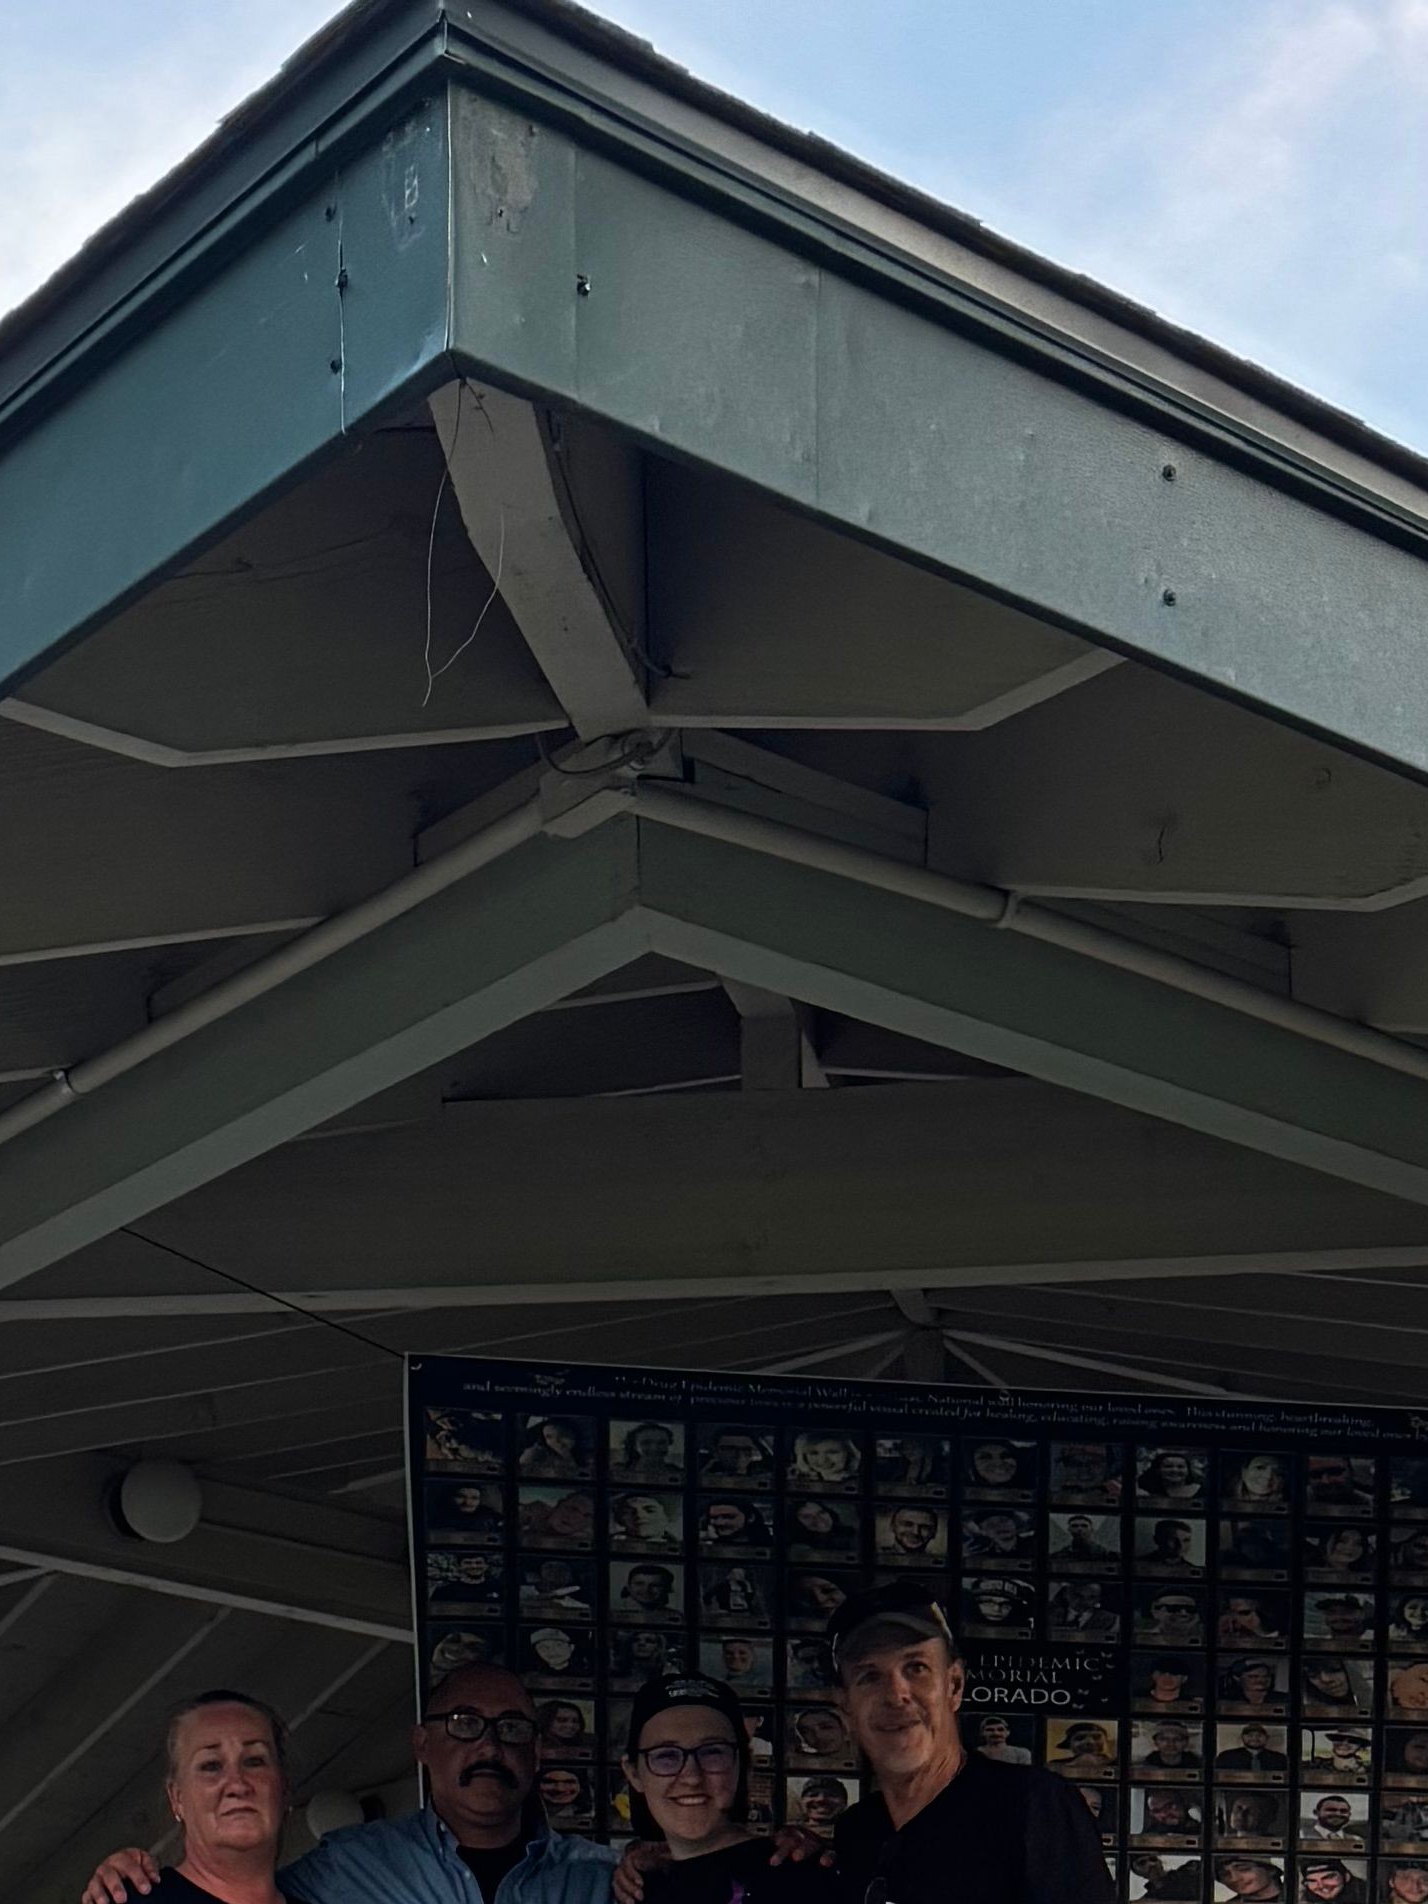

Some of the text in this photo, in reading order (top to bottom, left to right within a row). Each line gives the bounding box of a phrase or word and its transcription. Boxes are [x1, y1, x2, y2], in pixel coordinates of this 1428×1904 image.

[681, 1380, 742, 1393] Epidemic
[748, 1384, 812, 1397] Memorial
[815, 1387, 848, 1398] Wall
[462, 1381, 491, 1392] and
[493, 1384, 562, 1398] seemingly
[565, 1386, 616, 1398] endless
[619, 1391, 665, 1401] stream
[807, 1401, 867, 1415] powerful
[869, 1402, 908, 1414] visual
[911, 1406, 959, 1418] created
[1159, 1421, 1227, 1431] awareness
[1228, 1421, 1256, 1432] and
[1258, 1422, 1319, 1437] honoring
[1346, 1427, 1381, 1438] loved
[928, 1395, 984, 1407] National
[1018, 1396, 1078, 1413] honoring
[1107, 1402, 1142, 1414] loved
[980, 1654, 1100, 1671] EPIDEMIC
[966, 1668, 1063, 1684] MORIAL
[963, 1686, 1072, 1706] ORADO
